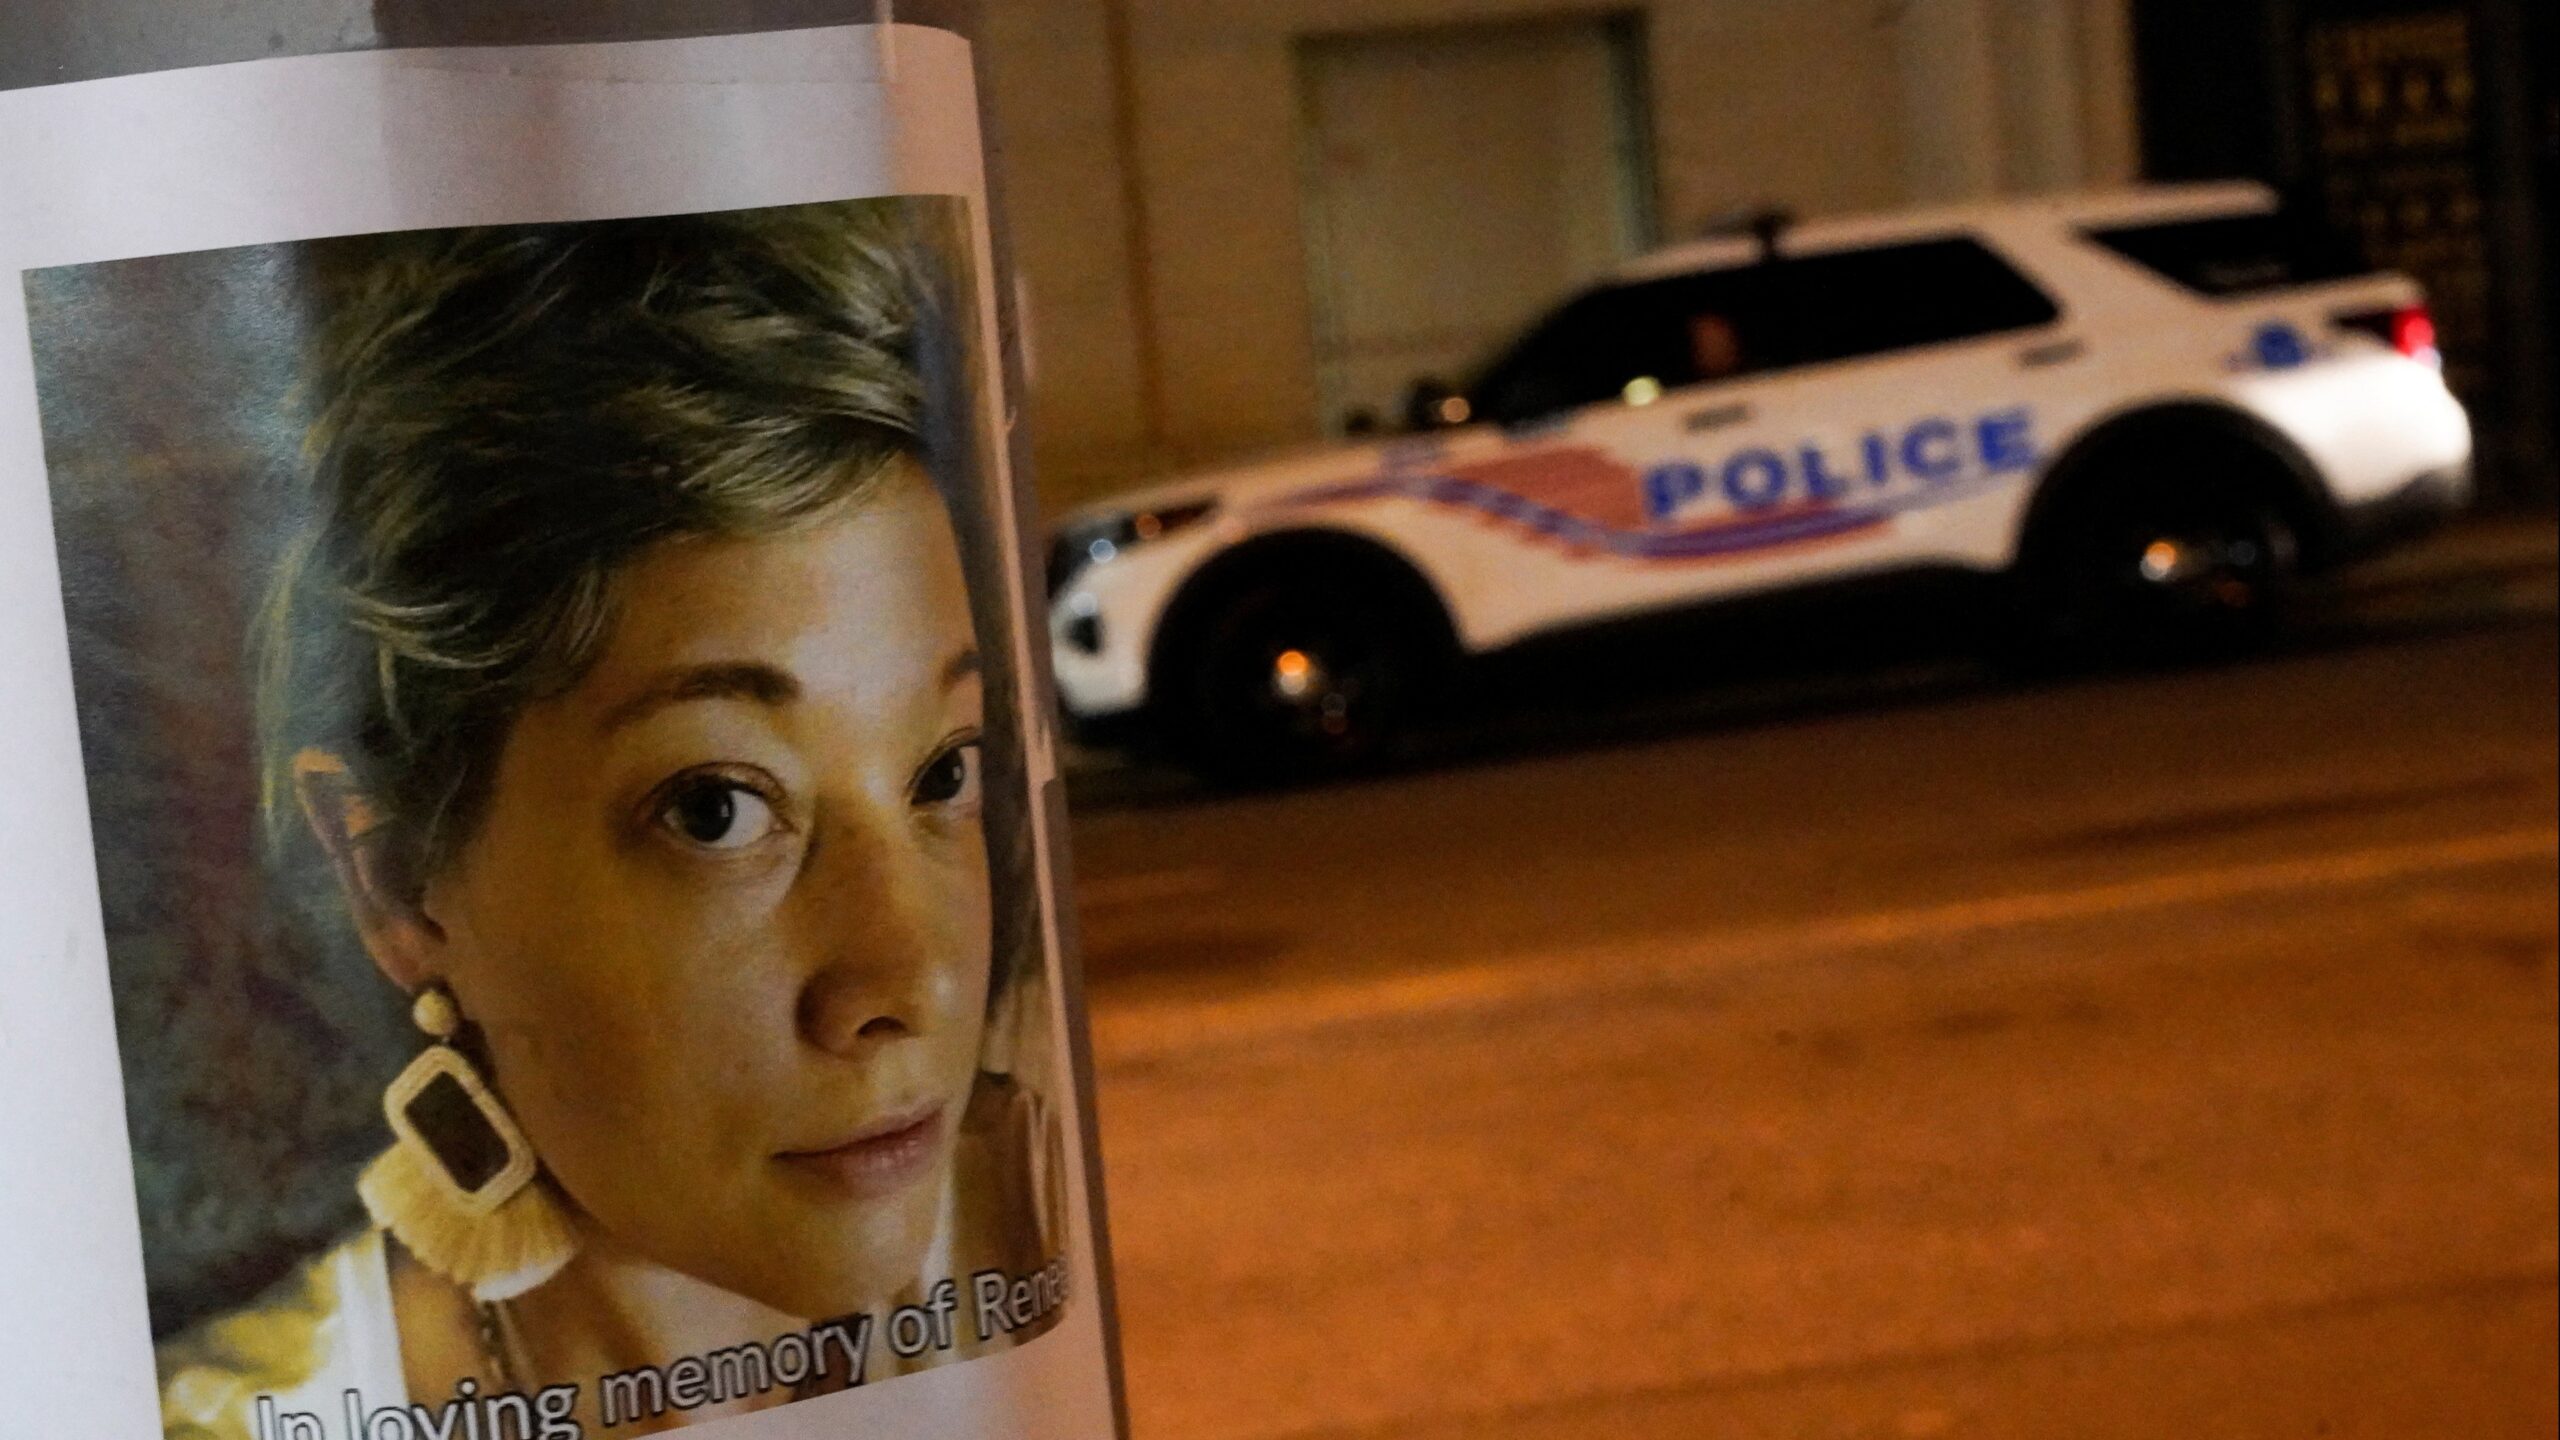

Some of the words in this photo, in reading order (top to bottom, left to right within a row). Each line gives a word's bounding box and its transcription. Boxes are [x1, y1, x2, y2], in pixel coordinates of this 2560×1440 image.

[1644, 406, 2038, 518] POLICE
[256, 1395, 324, 1440] In
[343, 1377, 580, 1440] loving
[600, 1312, 873, 1426] memory
[888, 1278, 957, 1357] of
